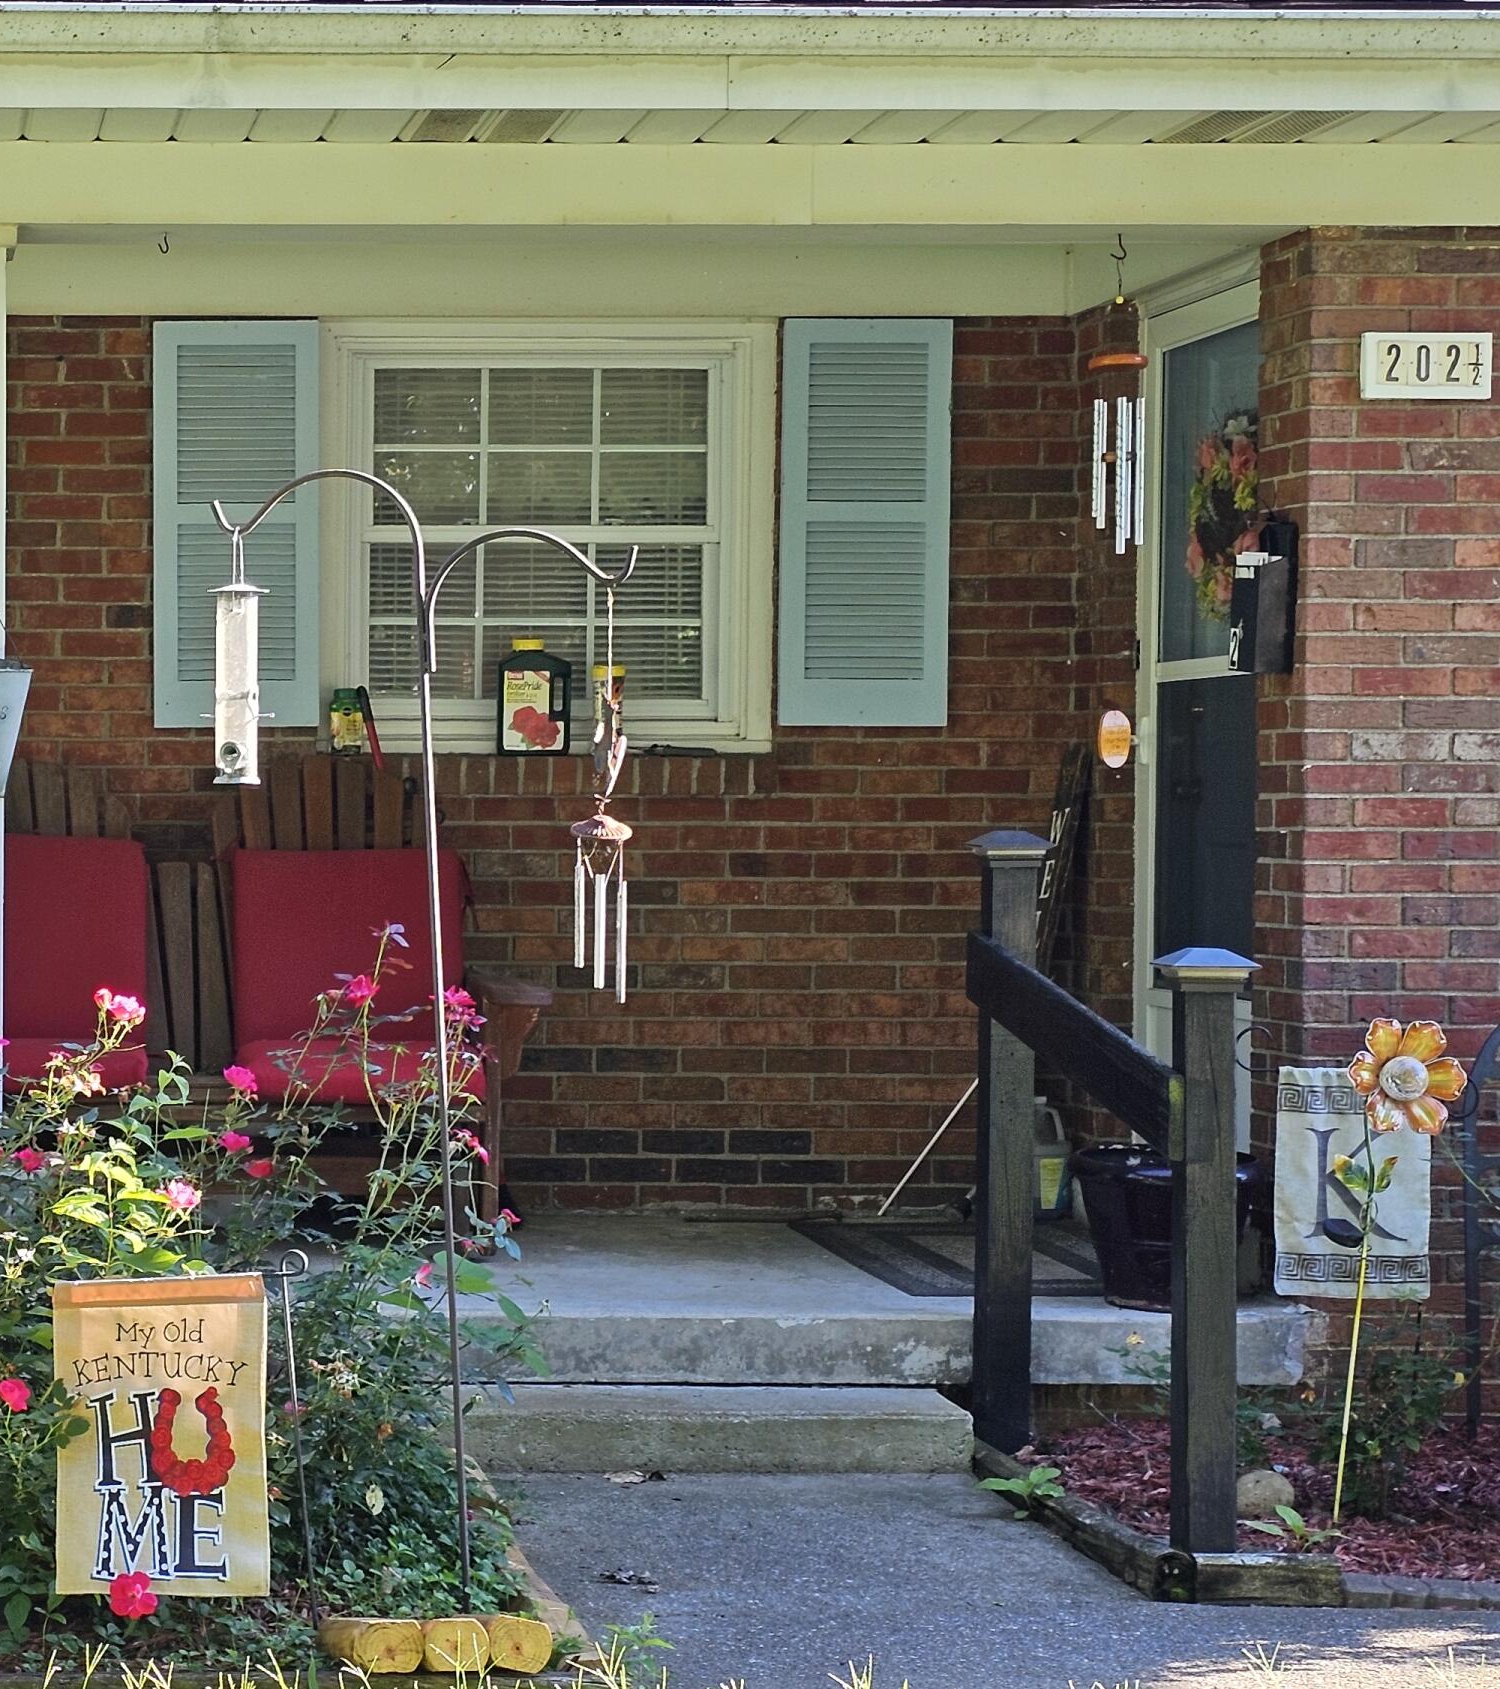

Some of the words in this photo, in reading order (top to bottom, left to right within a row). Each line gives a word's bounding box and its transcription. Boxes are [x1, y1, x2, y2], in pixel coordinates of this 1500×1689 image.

[1230, 630, 1238, 668] 2
[1304, 1127, 1408, 1241] K
[115, 1322, 155, 1349] My
[163, 1317, 205, 1344] Old
[72, 1351, 249, 1388] KENTUCKY
